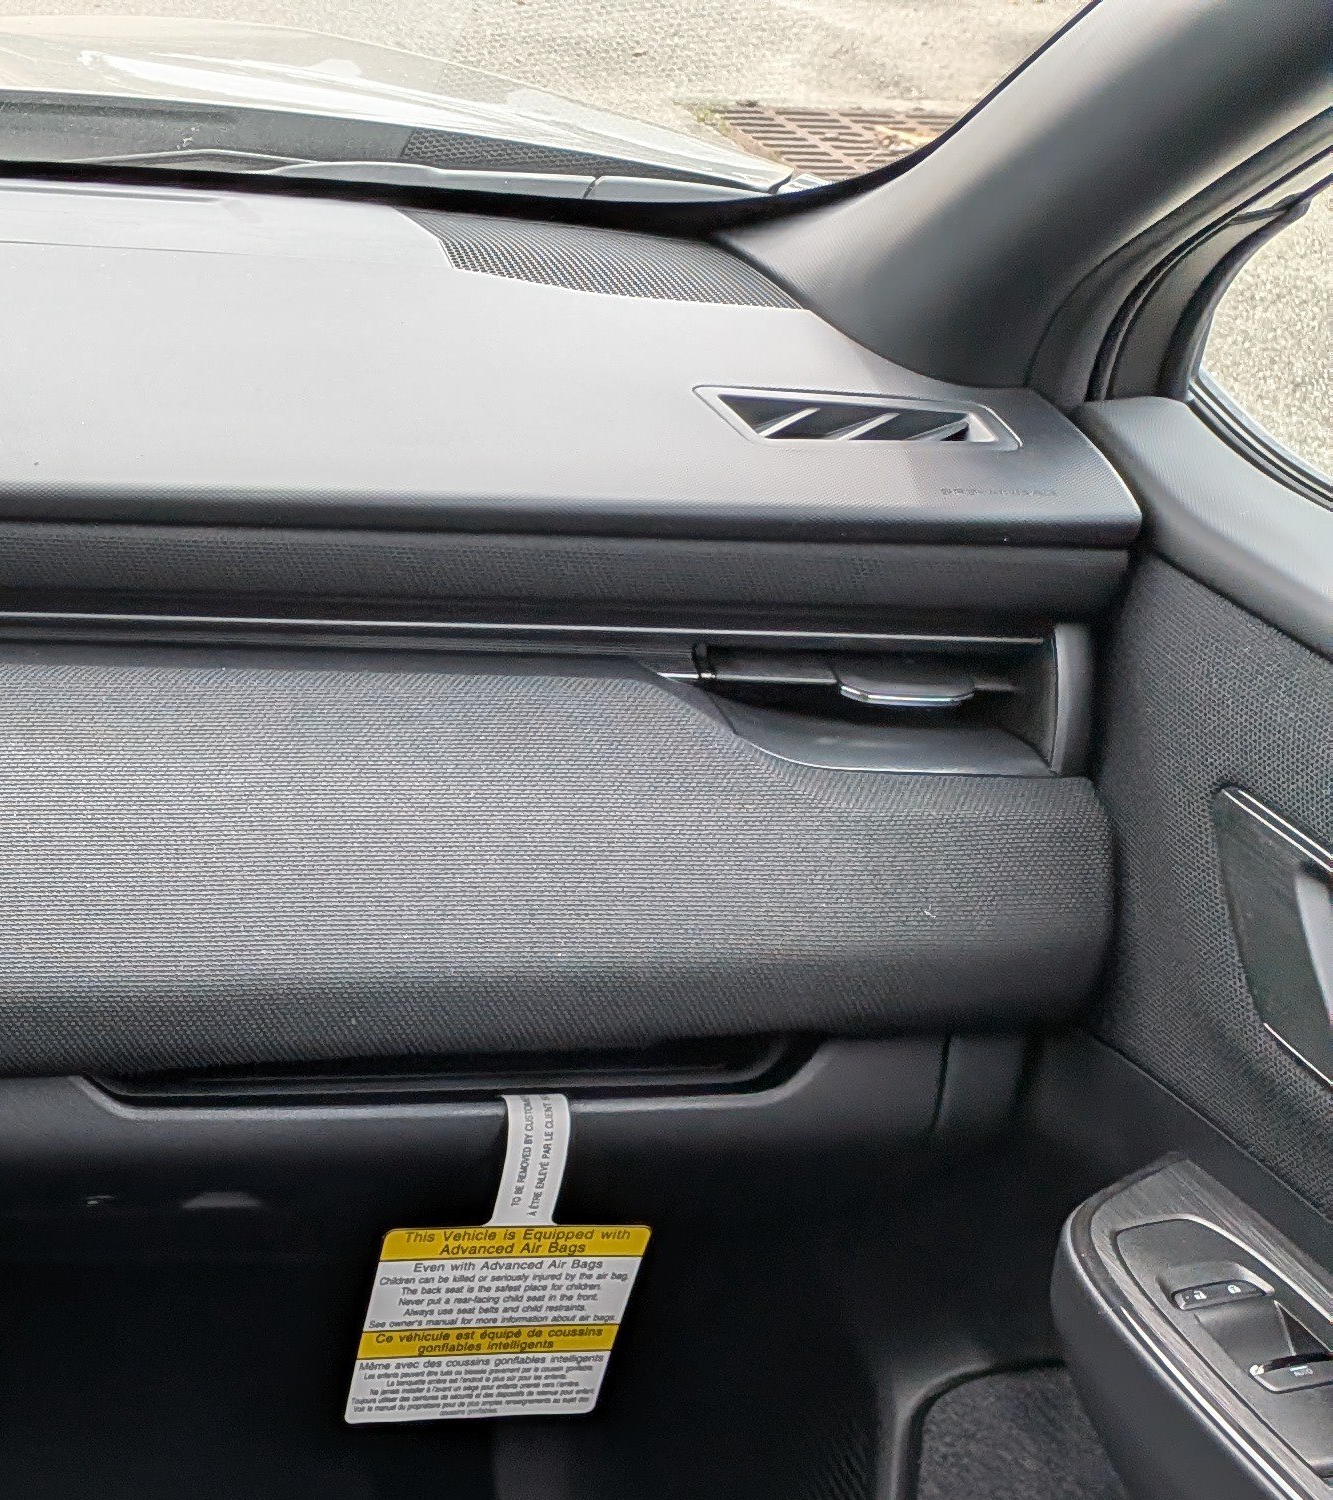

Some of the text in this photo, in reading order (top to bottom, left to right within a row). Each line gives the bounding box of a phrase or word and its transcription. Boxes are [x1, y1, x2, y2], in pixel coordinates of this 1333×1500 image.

[524, 1133, 534, 1145] BY
[545, 1131, 554, 1141] LE
[542, 1143, 552, 1160] PAR
[517, 1146, 532, 1183] REMOVED
[405, 1229, 631, 1243] This Vehicle is Equipped with
[439, 1242, 587, 1256] Advanced Air Bags
[413, 1260, 604, 1273] Even with Advanced Air Bags
[379, 1276, 416, 1286] Children
[418, 1276, 435, 1284] can
[452, 1274, 475, 1283] killed
[490, 1274, 530, 1283] seriously
[532, 1273, 562, 1282] injured
[564, 1273, 577, 1282] by
[579, 1272, 593, 1280] the
[596, 1272, 608, 1280] air
[401, 1287, 418, 1295] The
[420, 1287, 442, 1295] back
[444, 1286, 464, 1294] seat
[478, 1285, 492, 1293] the
[494, 1284, 521, 1293] safest
[523, 1283, 548, 1293] place
[550, 1283, 563, 1291] for
[398, 1297, 424, 1307] Never
[426, 1298, 442, 1306] put
[502, 1294, 523, 1303] child
[526, 1294, 545, 1302] seat
[547, 1293, 557, 1301] in
[559, 1293, 574, 1301] the
[403, 1304, 543, 1318] Always use seat belts and child
[369, 1320, 387, 1329] See
[425, 1318, 458, 1327] manual
[461, 1317, 472, 1325] for
[474, 1317, 498, 1325] more
[375, 1327, 604, 1344] Ce véhicule est équipé de coussins
[417, 1340, 554, 1356] gonflables intelligents
[359, 1361, 391, 1371] Même
[394, 1361, 420, 1369] avec
[423, 1360, 442, 1368] des
[445, 1358, 491, 1368] coussins
[494, 1356, 546, 1367] gonflables
